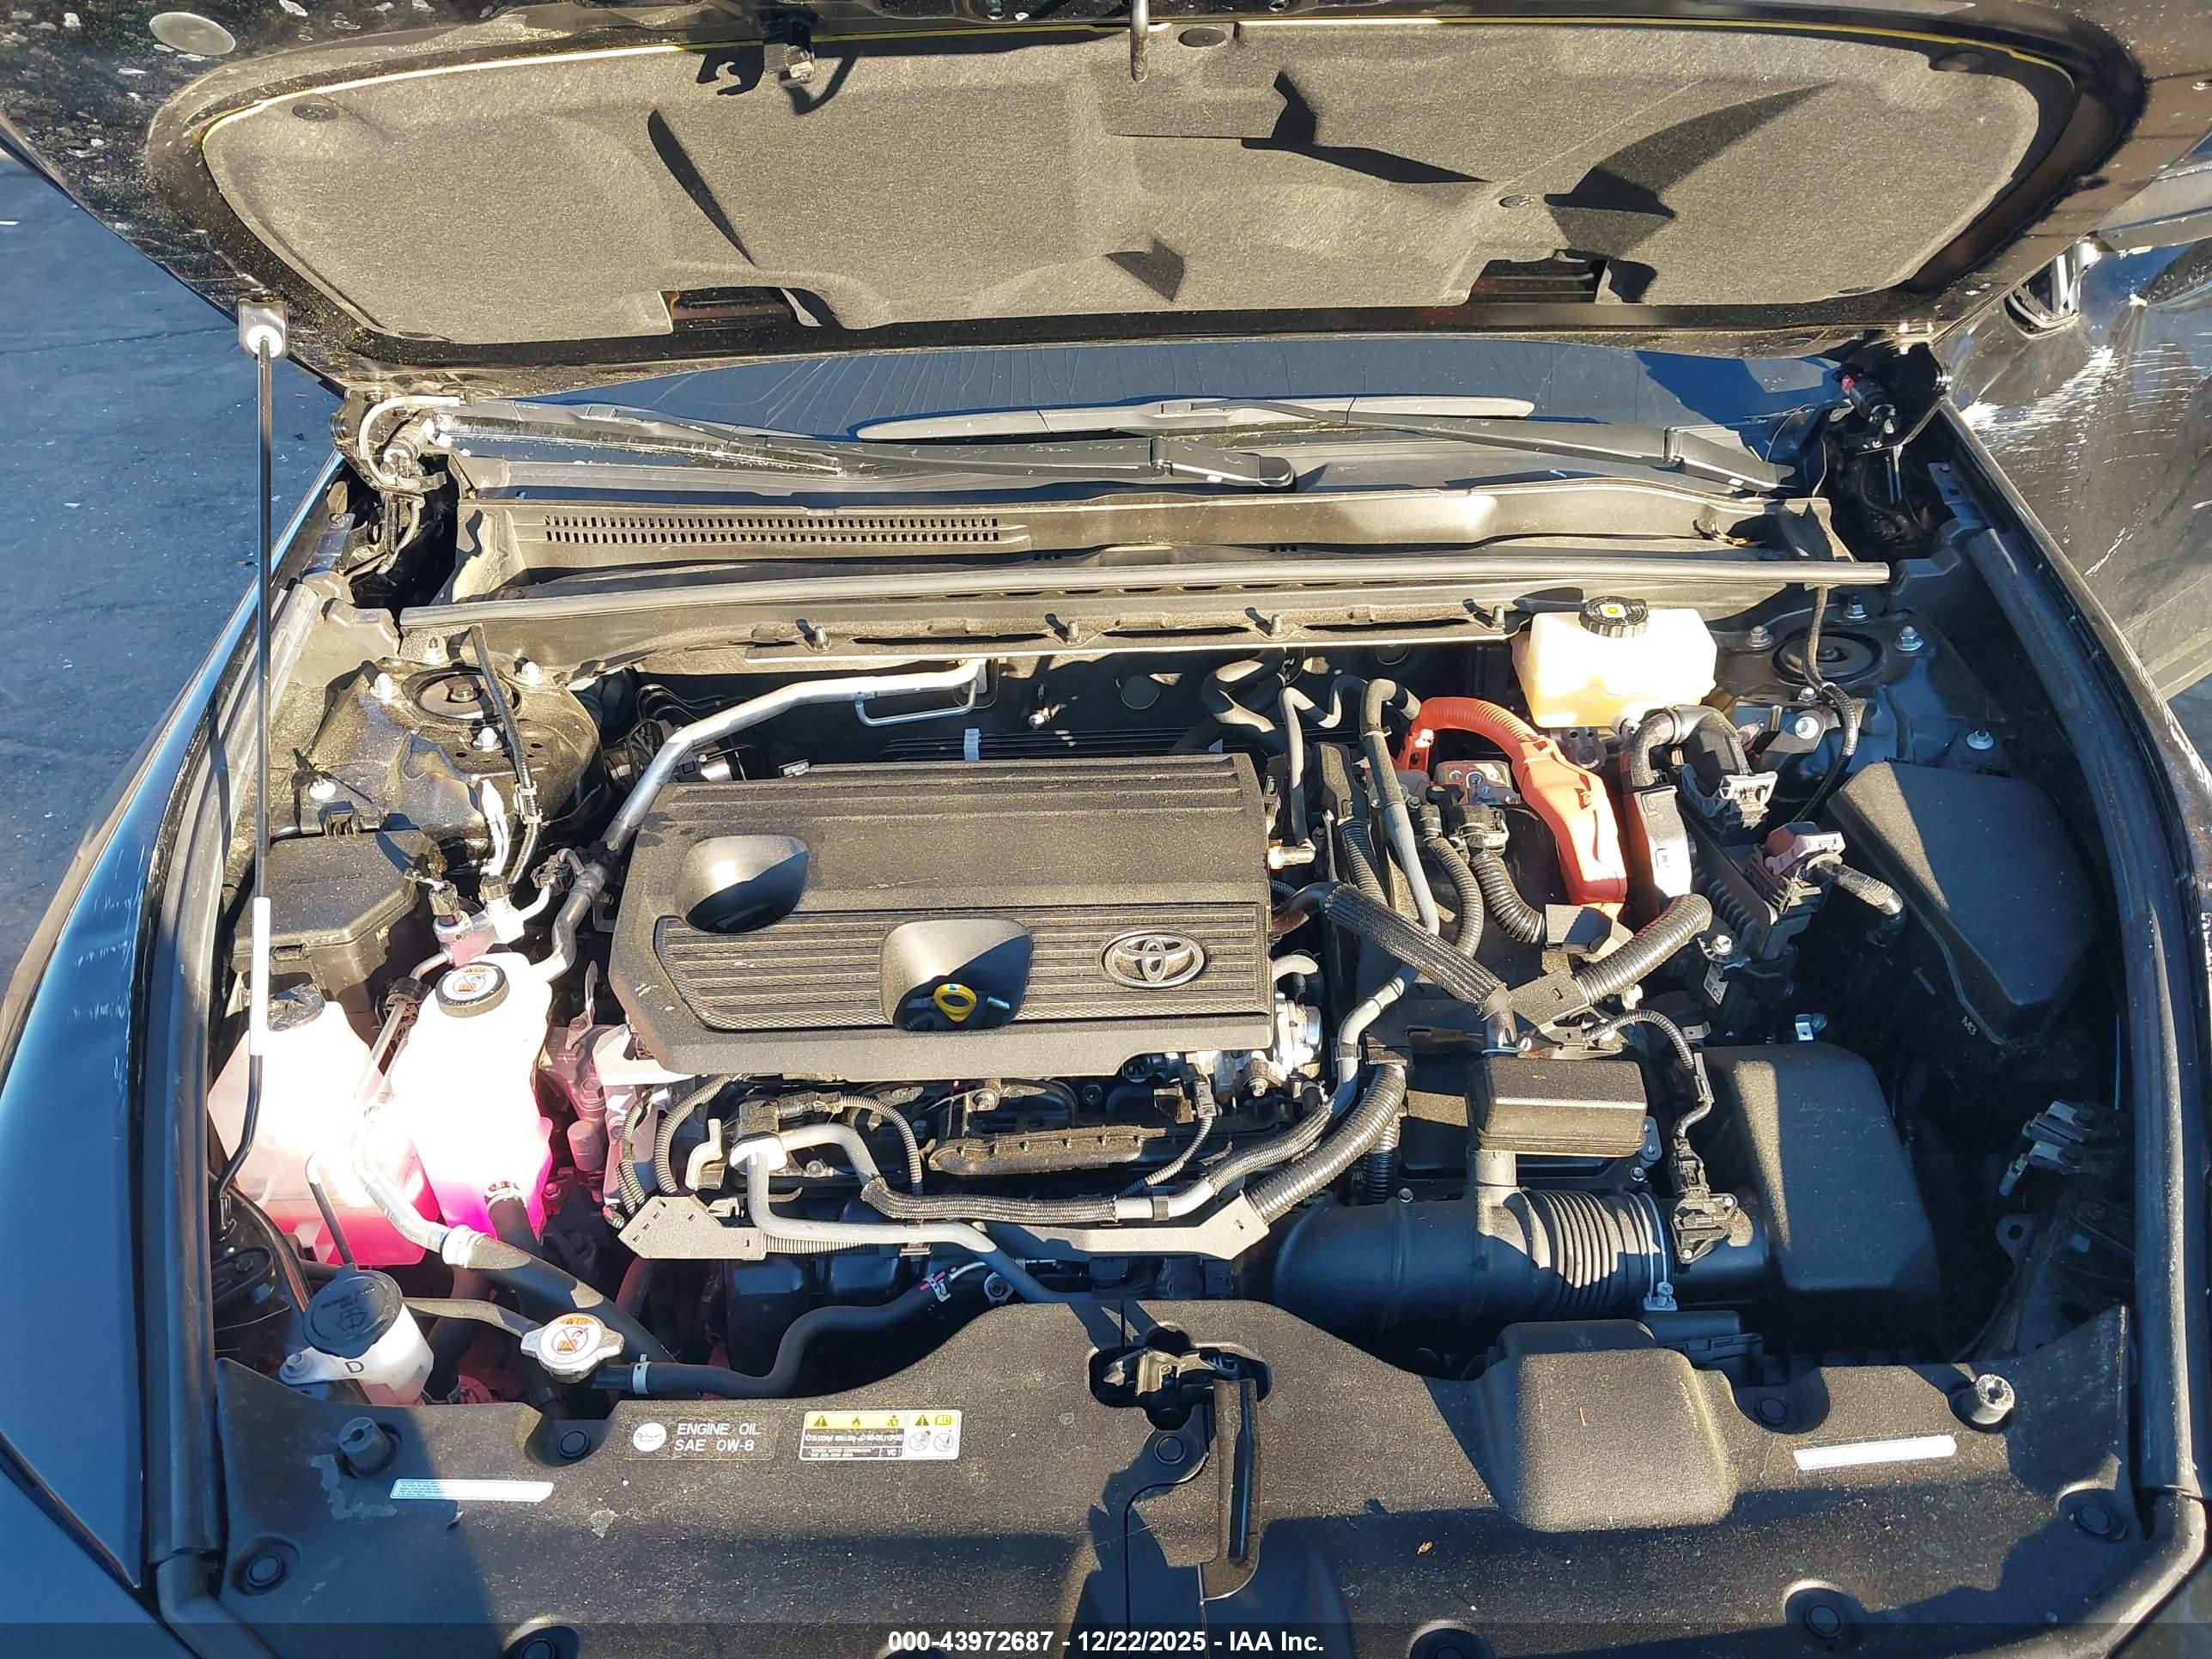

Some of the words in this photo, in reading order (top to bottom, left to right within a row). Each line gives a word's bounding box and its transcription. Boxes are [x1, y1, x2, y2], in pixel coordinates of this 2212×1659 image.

[1961, 1016, 1977, 1036] M3
[344, 1360, 365, 1374] D
[677, 1423, 731, 1436] ENGINE
[738, 1423, 761, 1436] OIL
[673, 1439, 707, 1452] SAE
